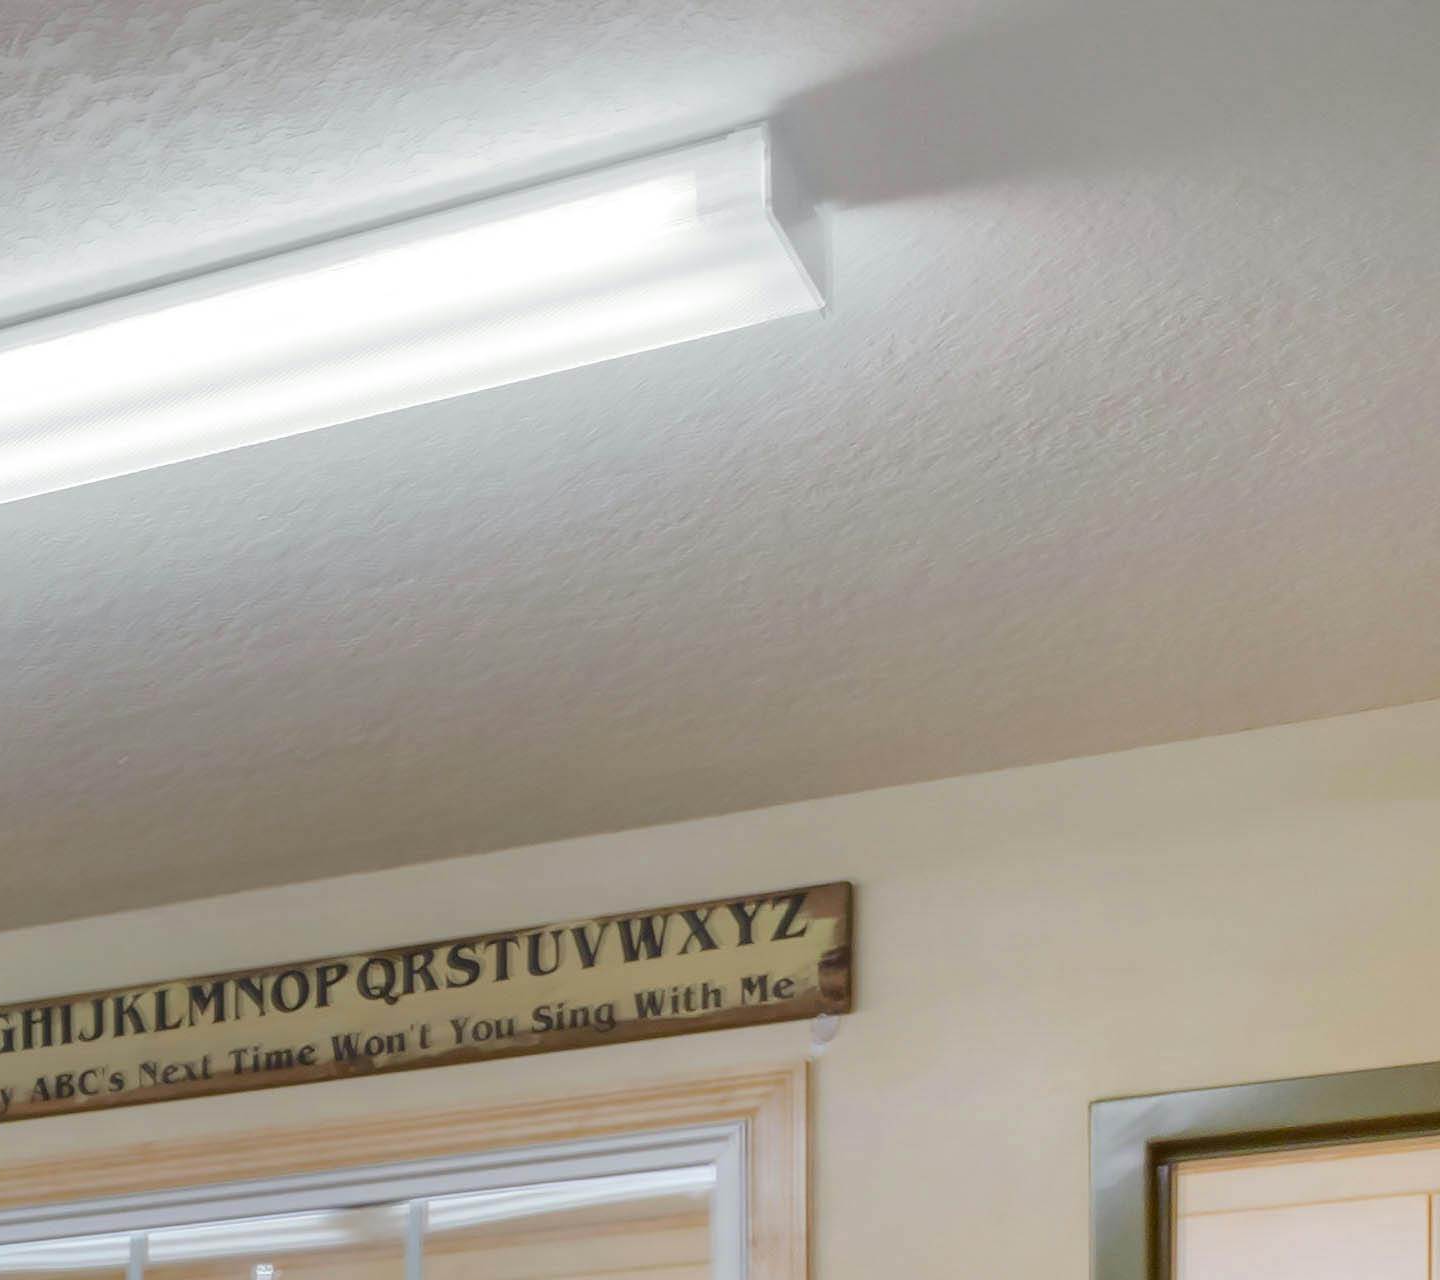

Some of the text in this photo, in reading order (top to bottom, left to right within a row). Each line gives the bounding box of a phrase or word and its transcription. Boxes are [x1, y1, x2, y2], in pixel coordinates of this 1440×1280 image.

[30, 1067, 125, 1102] ABC's
[139, 1055, 212, 1088] Next
[229, 1040, 316, 1075] Time
[331, 1022, 432, 1063] Won't
[450, 1014, 516, 1044] You
[531, 1001, 616, 1035] Sing
[634, 982, 722, 1017] With
[740, 973, 796, 1003] Me
